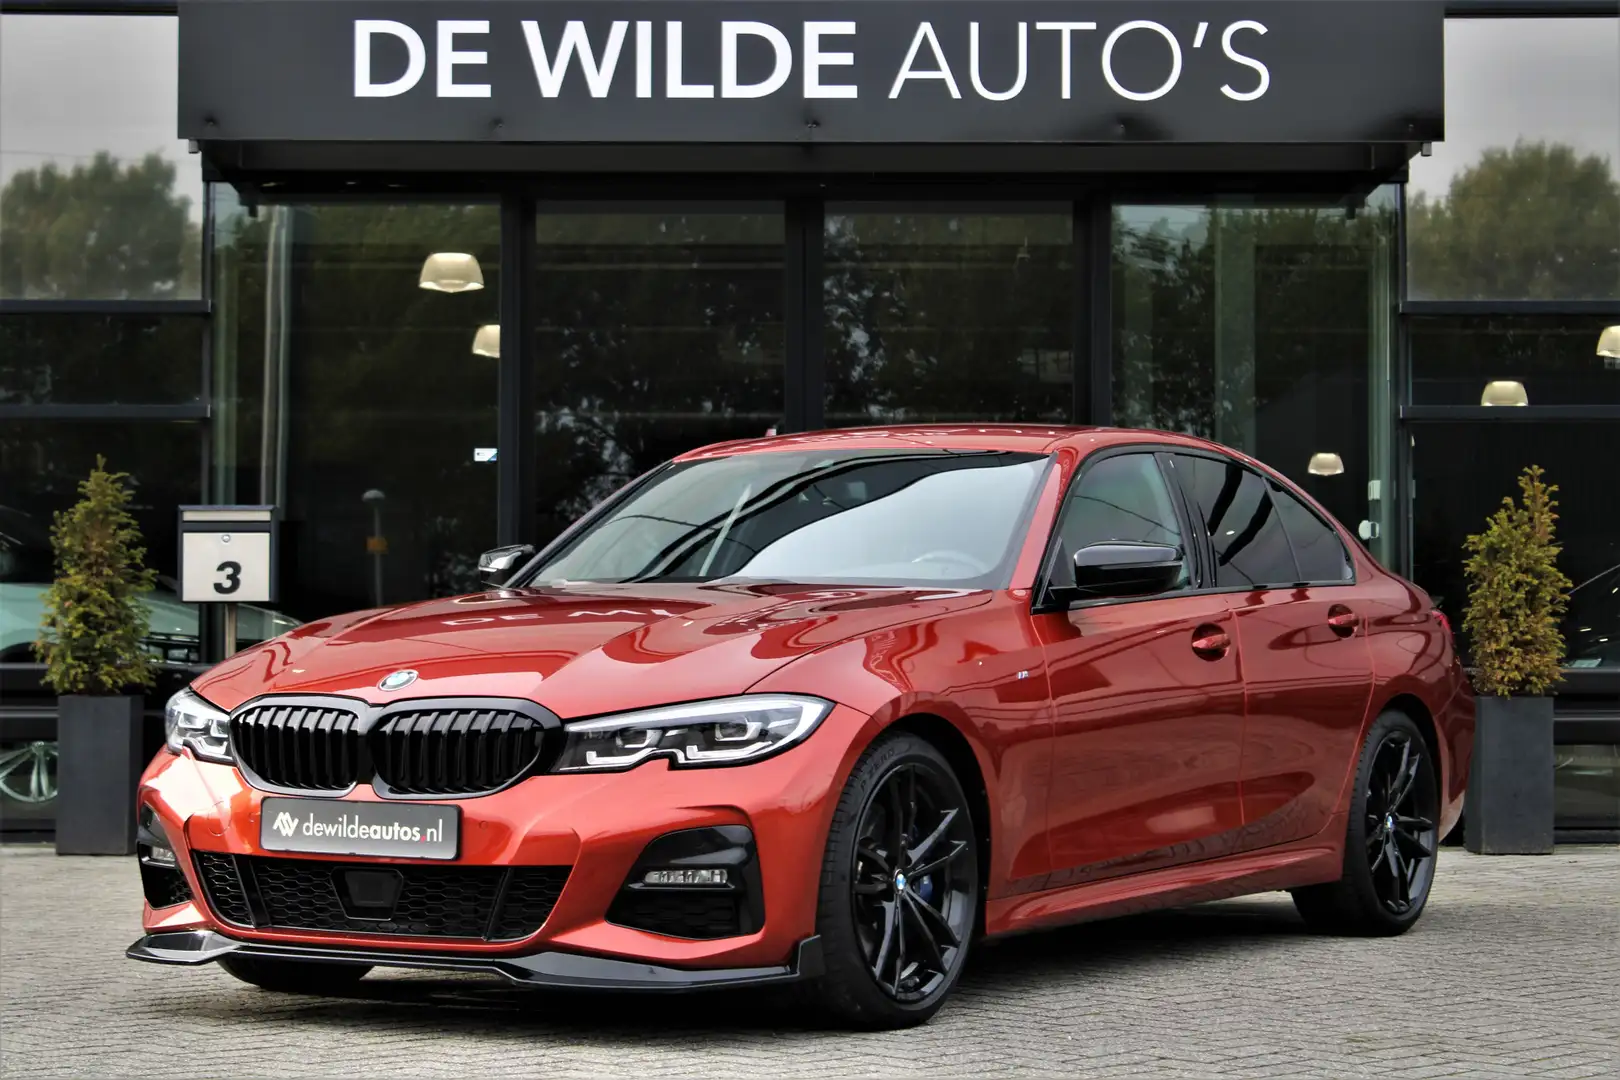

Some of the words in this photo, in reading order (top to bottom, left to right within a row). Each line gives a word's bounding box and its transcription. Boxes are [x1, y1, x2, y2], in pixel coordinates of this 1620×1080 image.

[354, 19, 492, 98] DE
[520, 20, 858, 99] WILDE
[888, 19, 1270, 102] AUTO'S
[213, 560, 242, 595] 3
[302, 812, 443, 843] dewildeautos.nl
